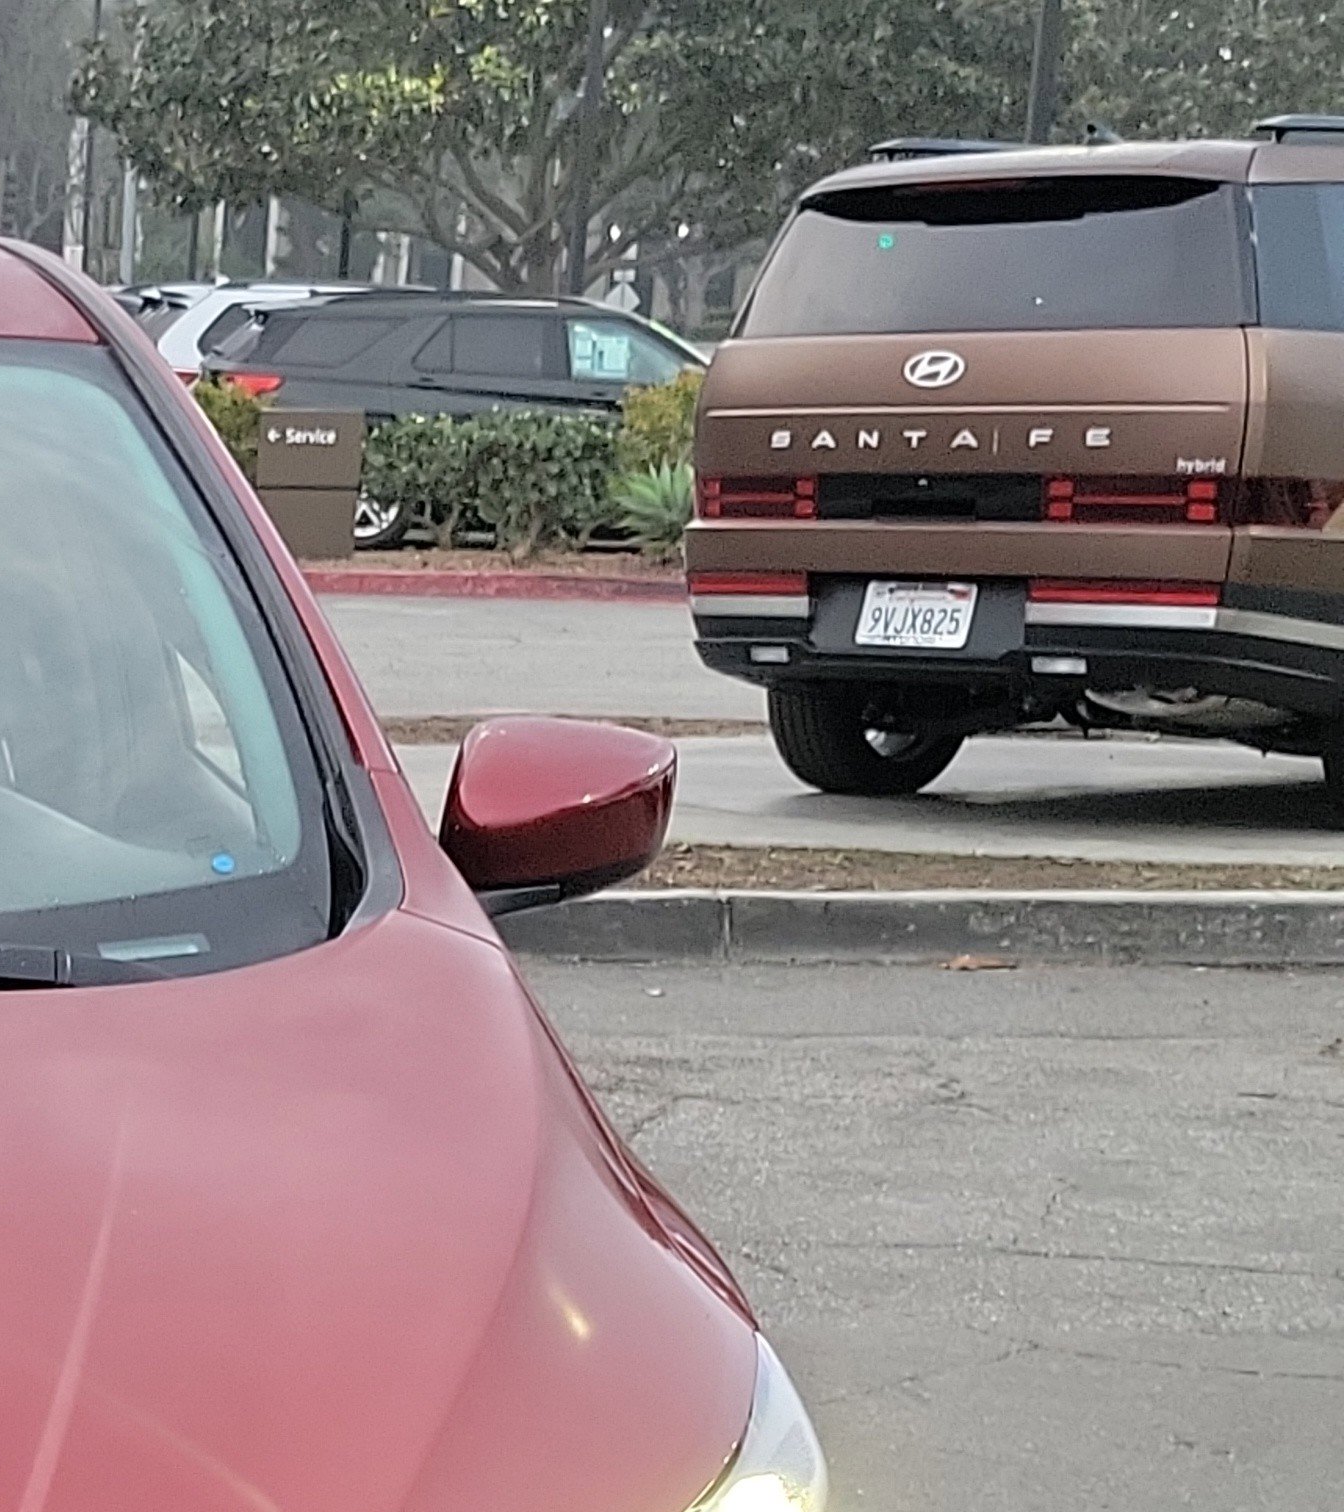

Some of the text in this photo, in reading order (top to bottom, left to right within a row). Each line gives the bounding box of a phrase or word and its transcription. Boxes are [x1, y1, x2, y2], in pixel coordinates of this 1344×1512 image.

[285, 428, 336, 445] Service
[770, 427, 1111, 450] SANTA FE
[1176, 457, 1226, 475] hybrid
[868, 606, 962, 636] 9VJX825
